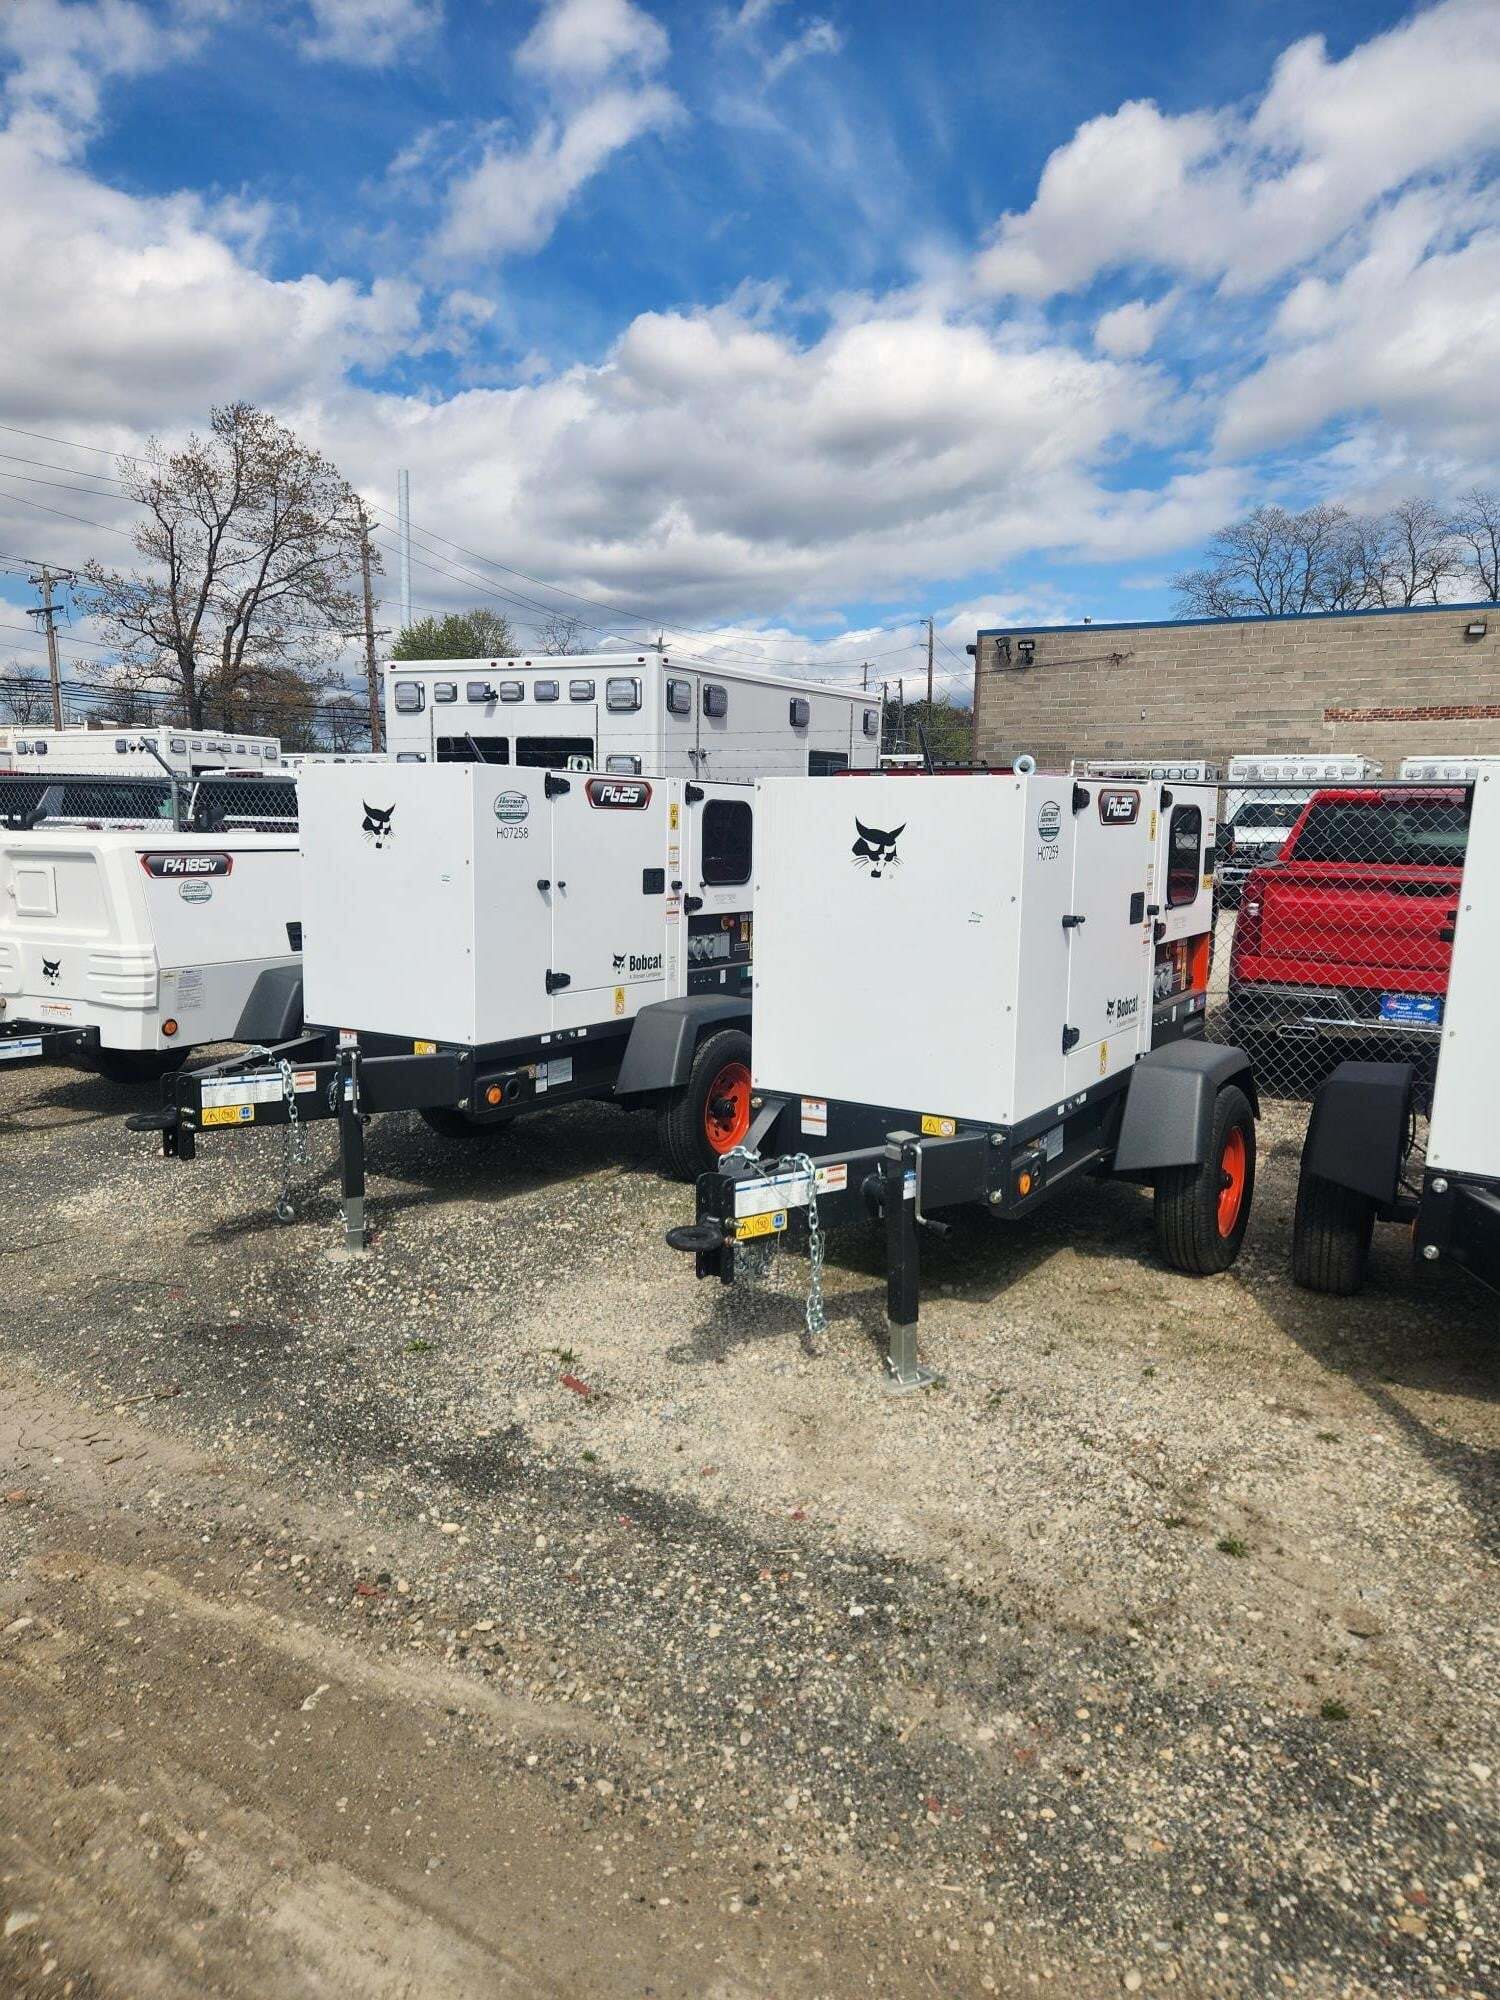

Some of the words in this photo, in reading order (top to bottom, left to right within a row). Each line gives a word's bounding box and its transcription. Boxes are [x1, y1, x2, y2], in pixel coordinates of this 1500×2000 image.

[601, 784, 640, 802] PG25
[1106, 796, 1133, 817] PG25
[629, 953, 662, 972] Bobcat
[1117, 993, 1138, 1018] Bobcat
